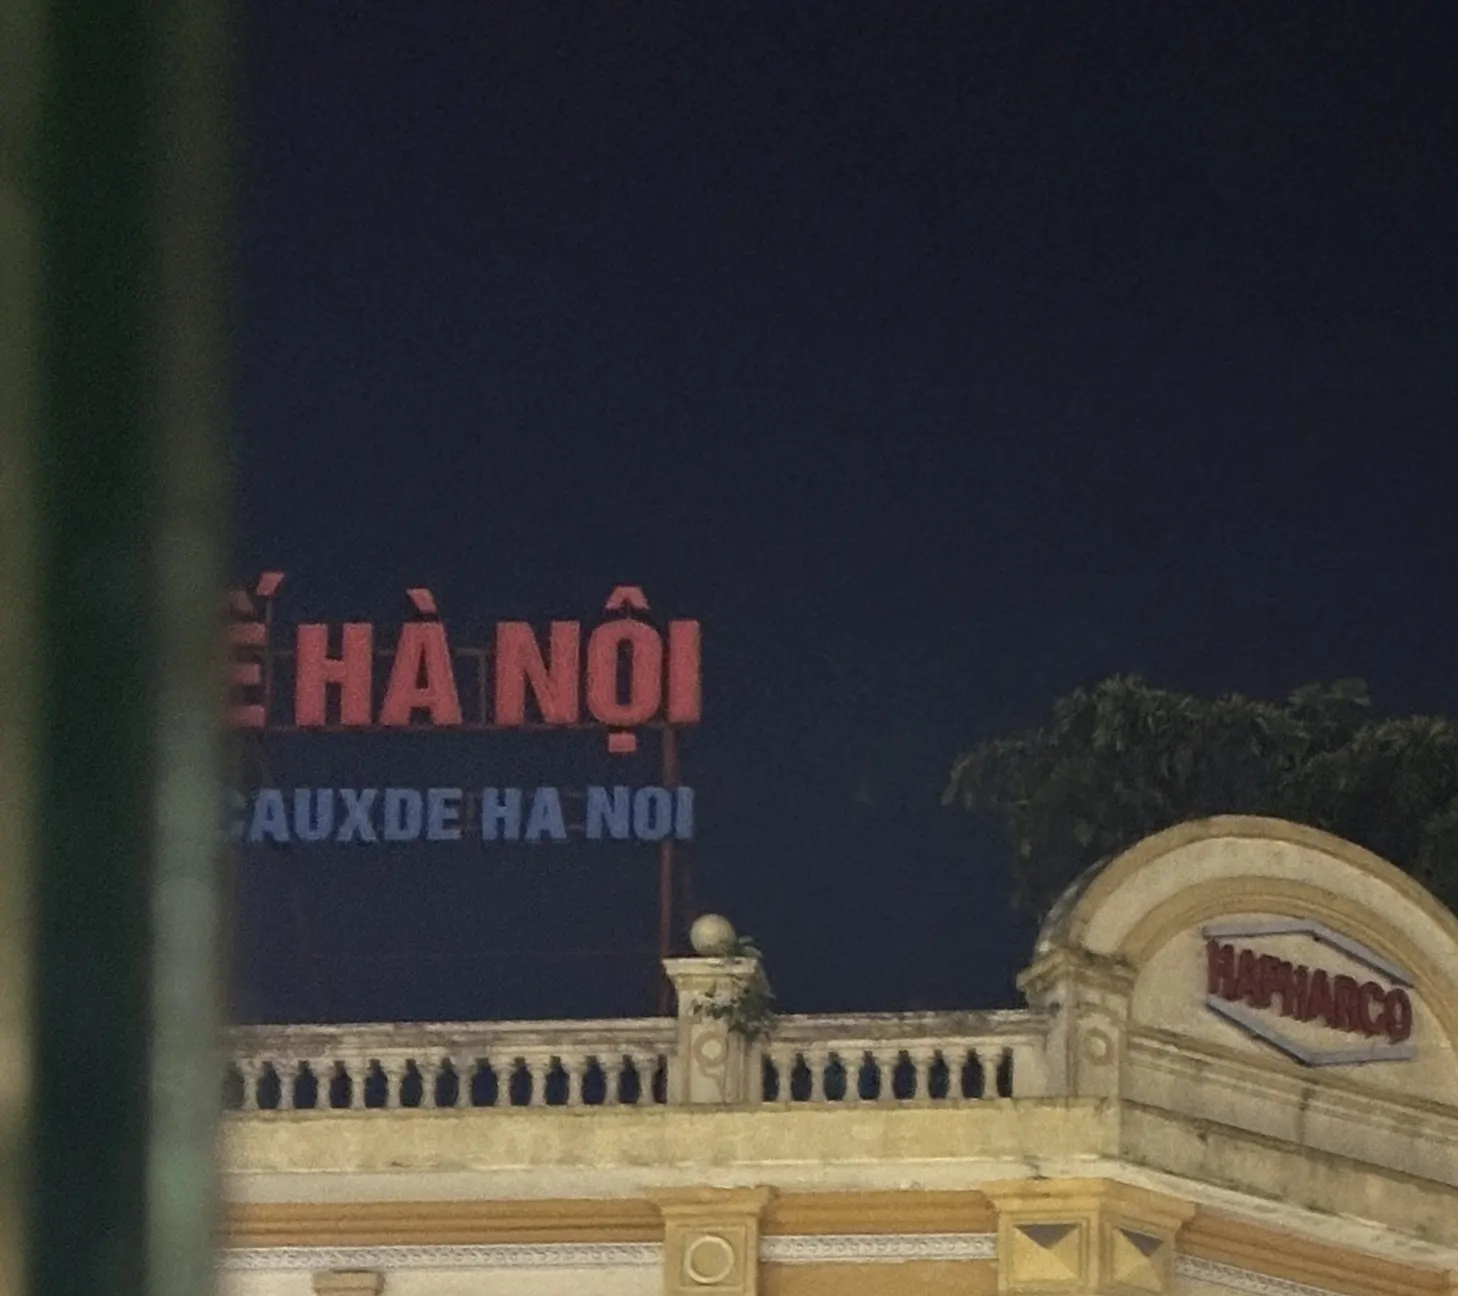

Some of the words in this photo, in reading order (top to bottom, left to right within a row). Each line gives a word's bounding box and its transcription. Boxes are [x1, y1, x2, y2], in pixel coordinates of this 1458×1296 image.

[295, 587, 463, 727] HÀ
[494, 585, 701, 753] NỘI
[480, 787, 567, 841] HA
[586, 786, 696, 841] NOI
